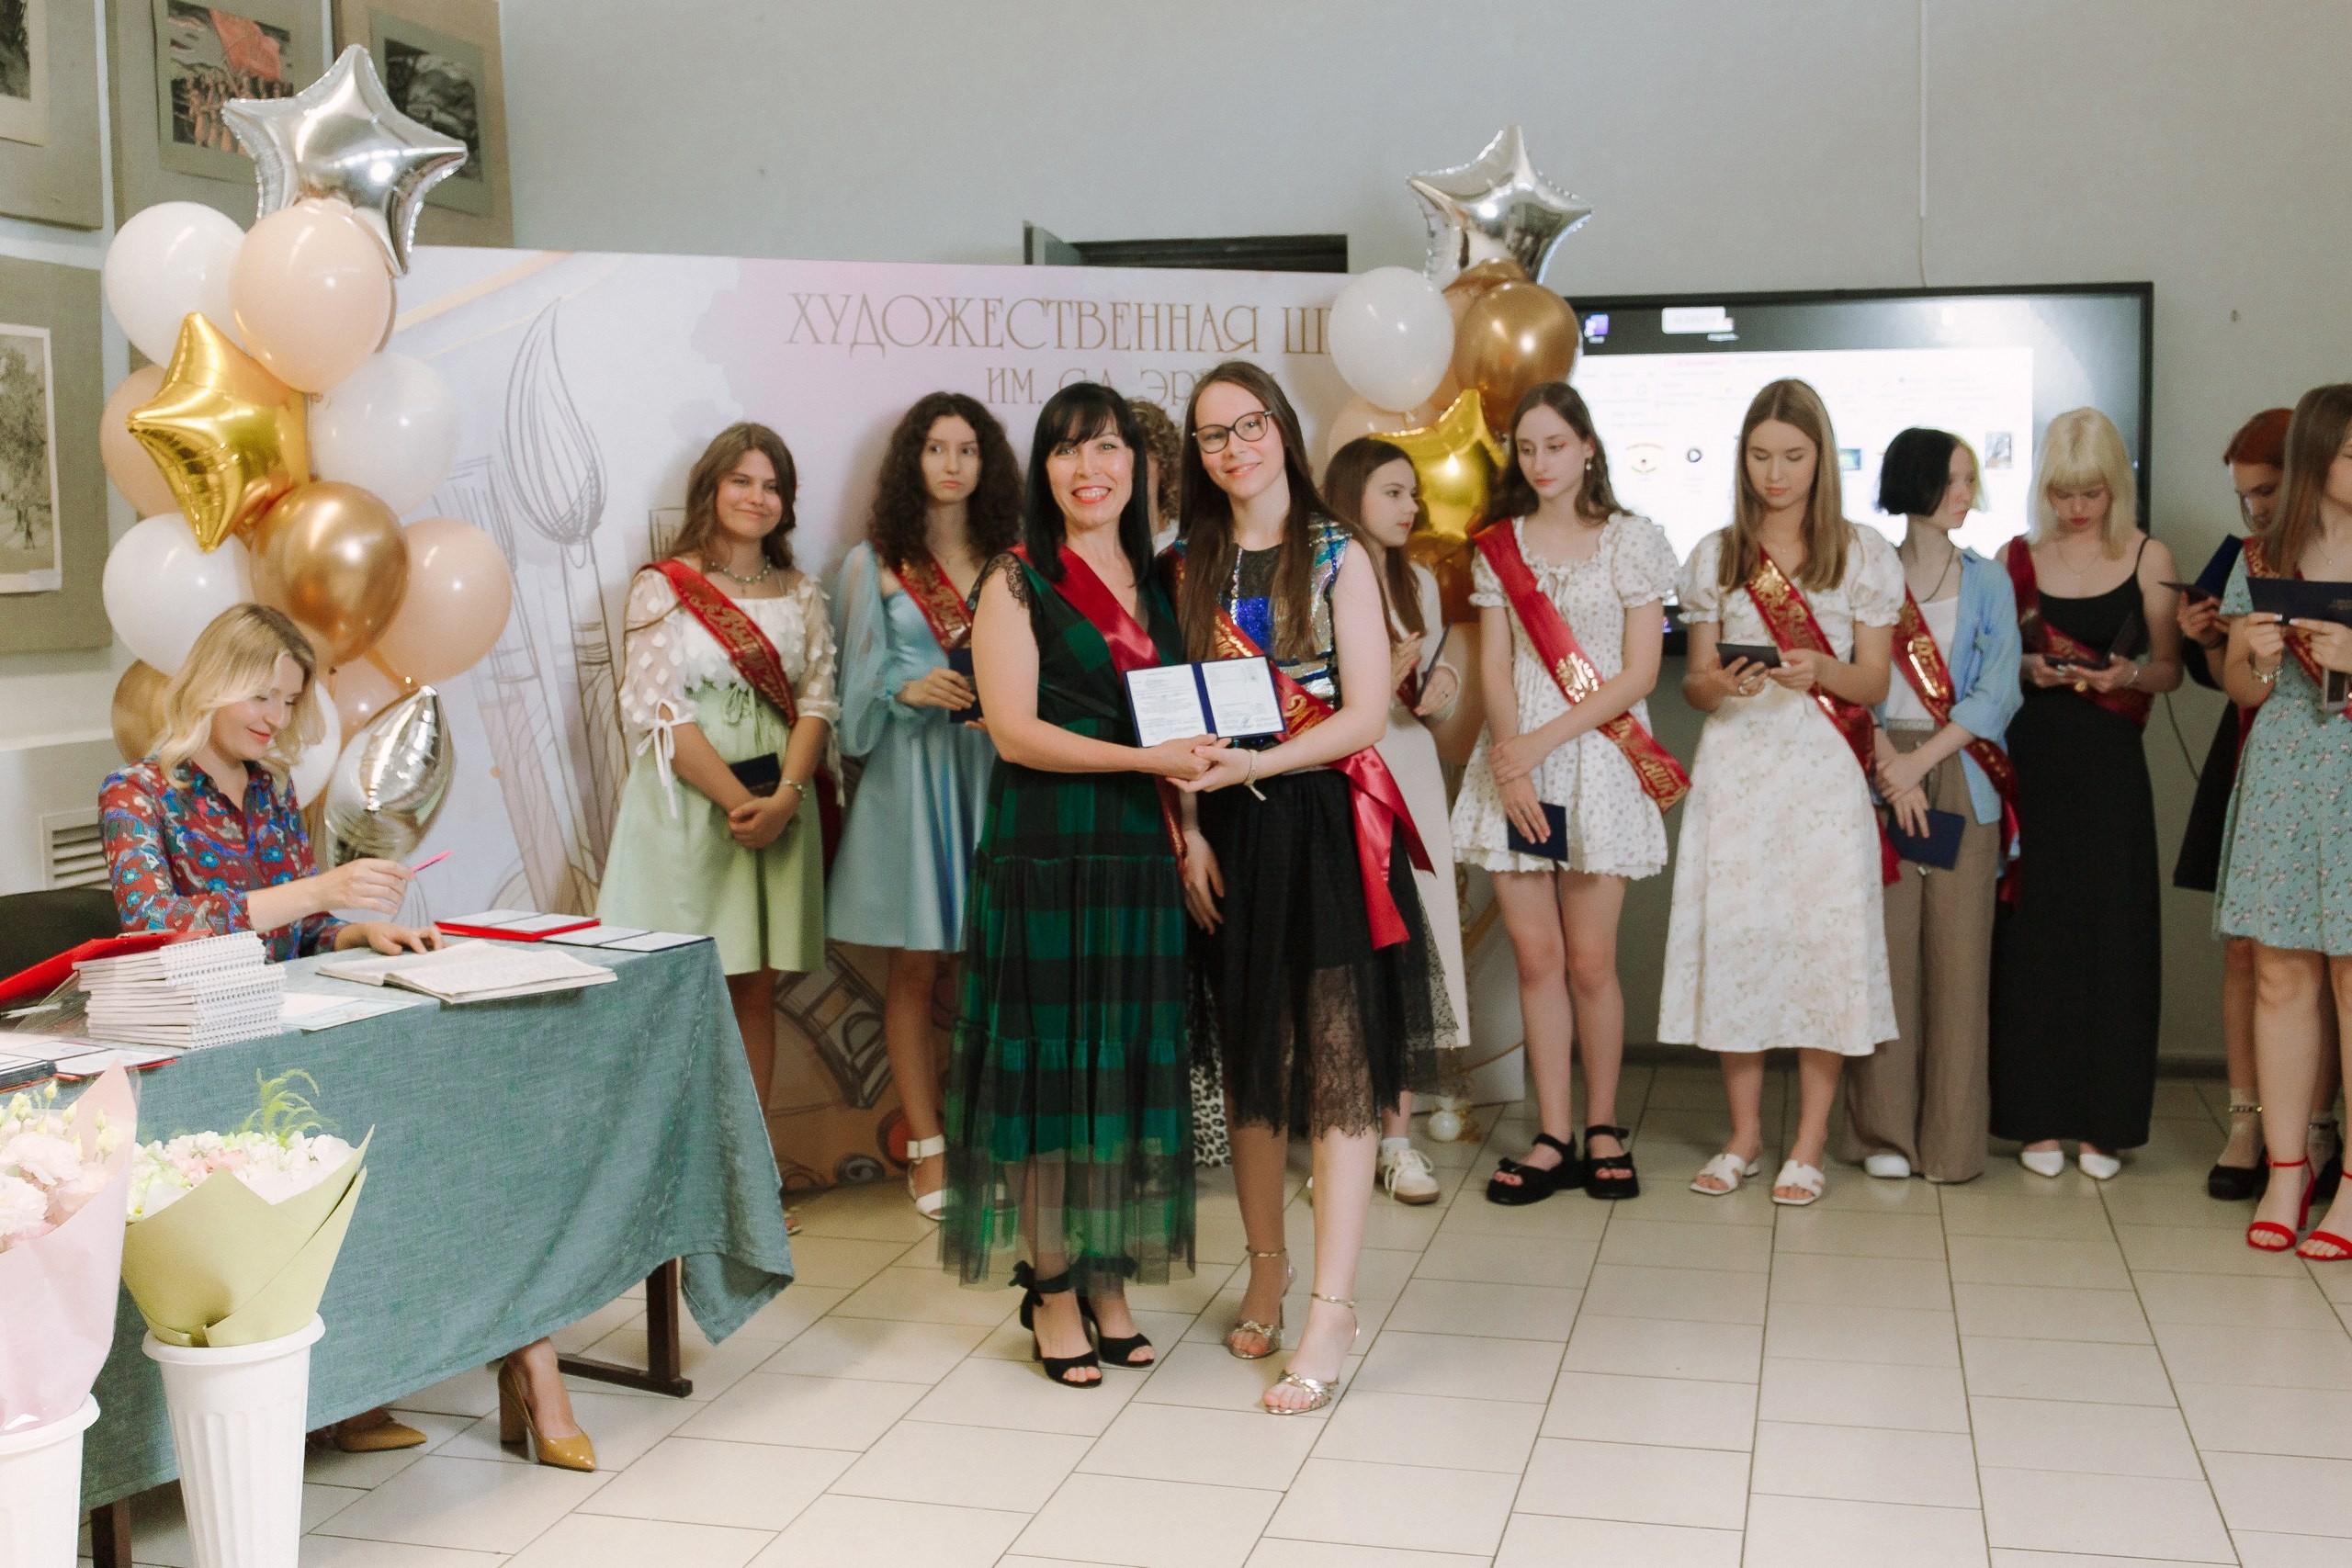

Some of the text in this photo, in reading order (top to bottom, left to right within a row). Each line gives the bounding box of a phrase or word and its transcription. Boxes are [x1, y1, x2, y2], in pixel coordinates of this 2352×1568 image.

[784, 292, 1331, 358] ХУДОЖЕСТВЕННАЯ Ш
[986, 367, 1044, 405] ИМ.
